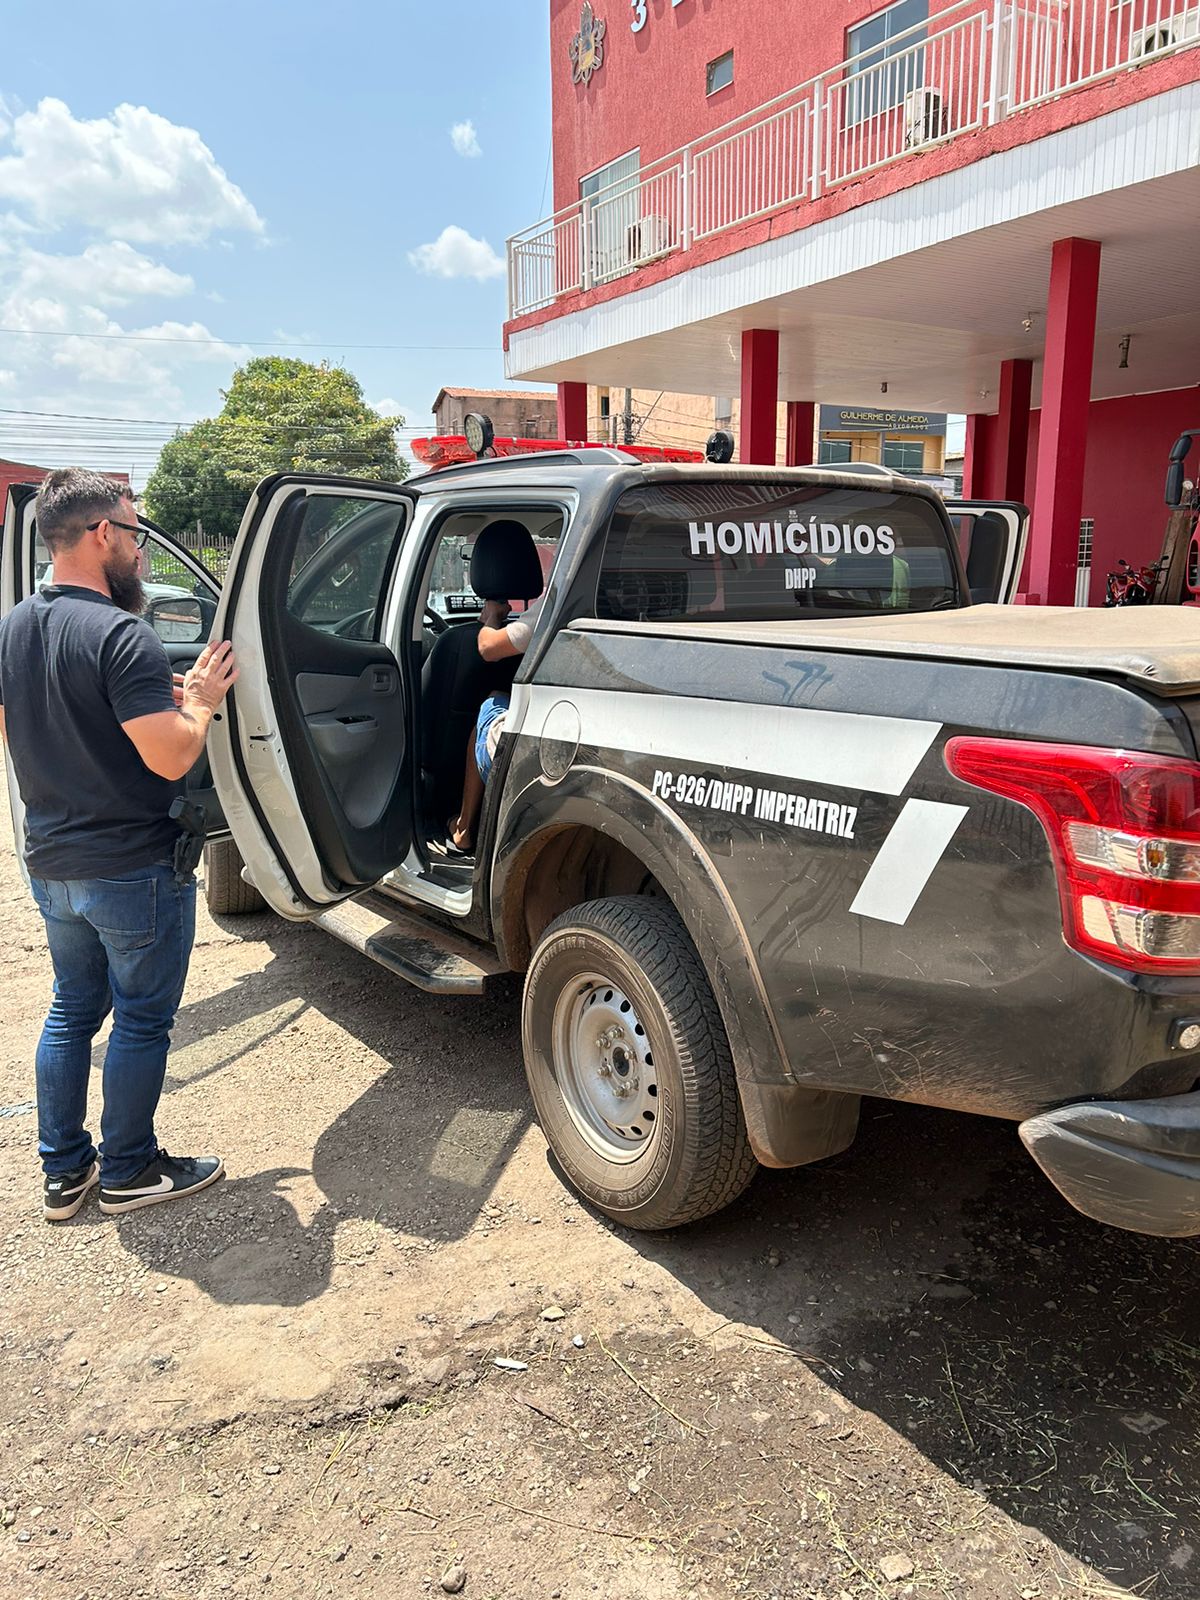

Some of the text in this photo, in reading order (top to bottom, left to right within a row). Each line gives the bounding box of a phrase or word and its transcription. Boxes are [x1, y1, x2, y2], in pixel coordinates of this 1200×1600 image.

[840, 411, 929, 424] GUILHERME DE ALMEIDA
[688, 516, 896, 555] HOMICÍDIOS
[785, 568, 817, 590] DHPP
[652, 770, 858, 839] PC-926/DHPP IMPERATRIZ
